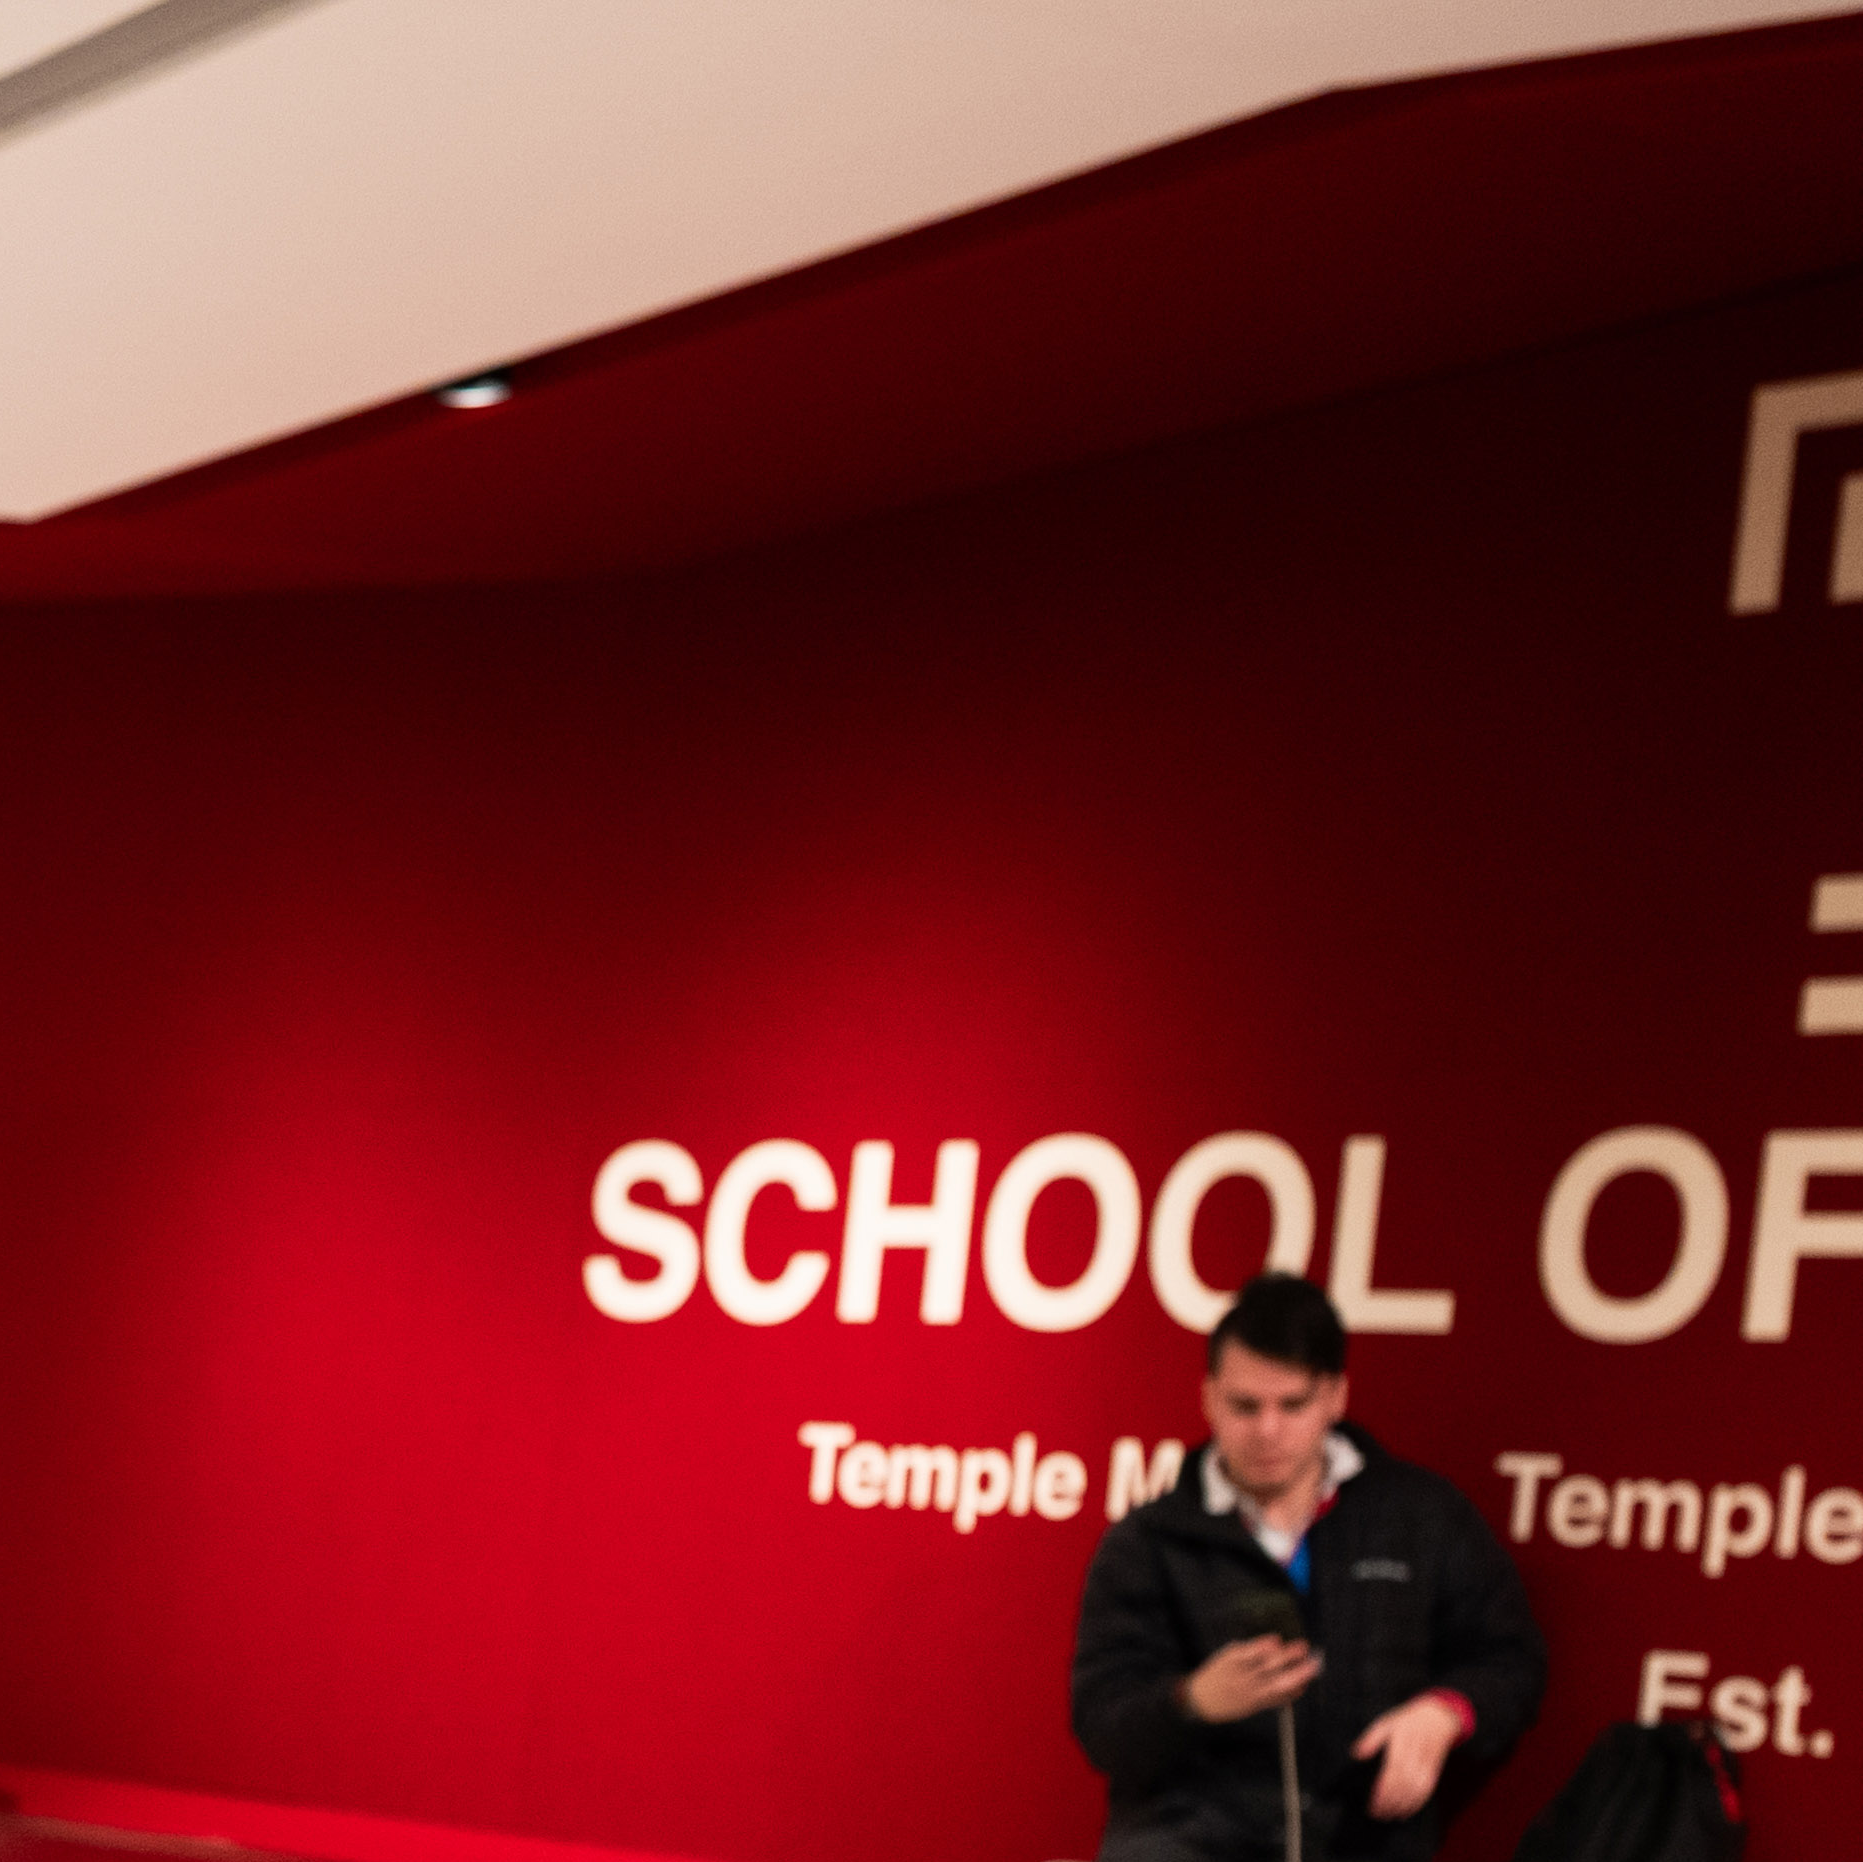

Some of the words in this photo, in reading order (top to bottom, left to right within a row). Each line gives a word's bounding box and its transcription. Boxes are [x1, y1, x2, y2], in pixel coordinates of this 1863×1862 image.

[581, 1130, 1455, 1336] SCHOOL
[1537, 1126, 1863, 1344] OF
[797, 1421, 1088, 1534] Temple
[1495, 1452, 1863, 1578] Temple
